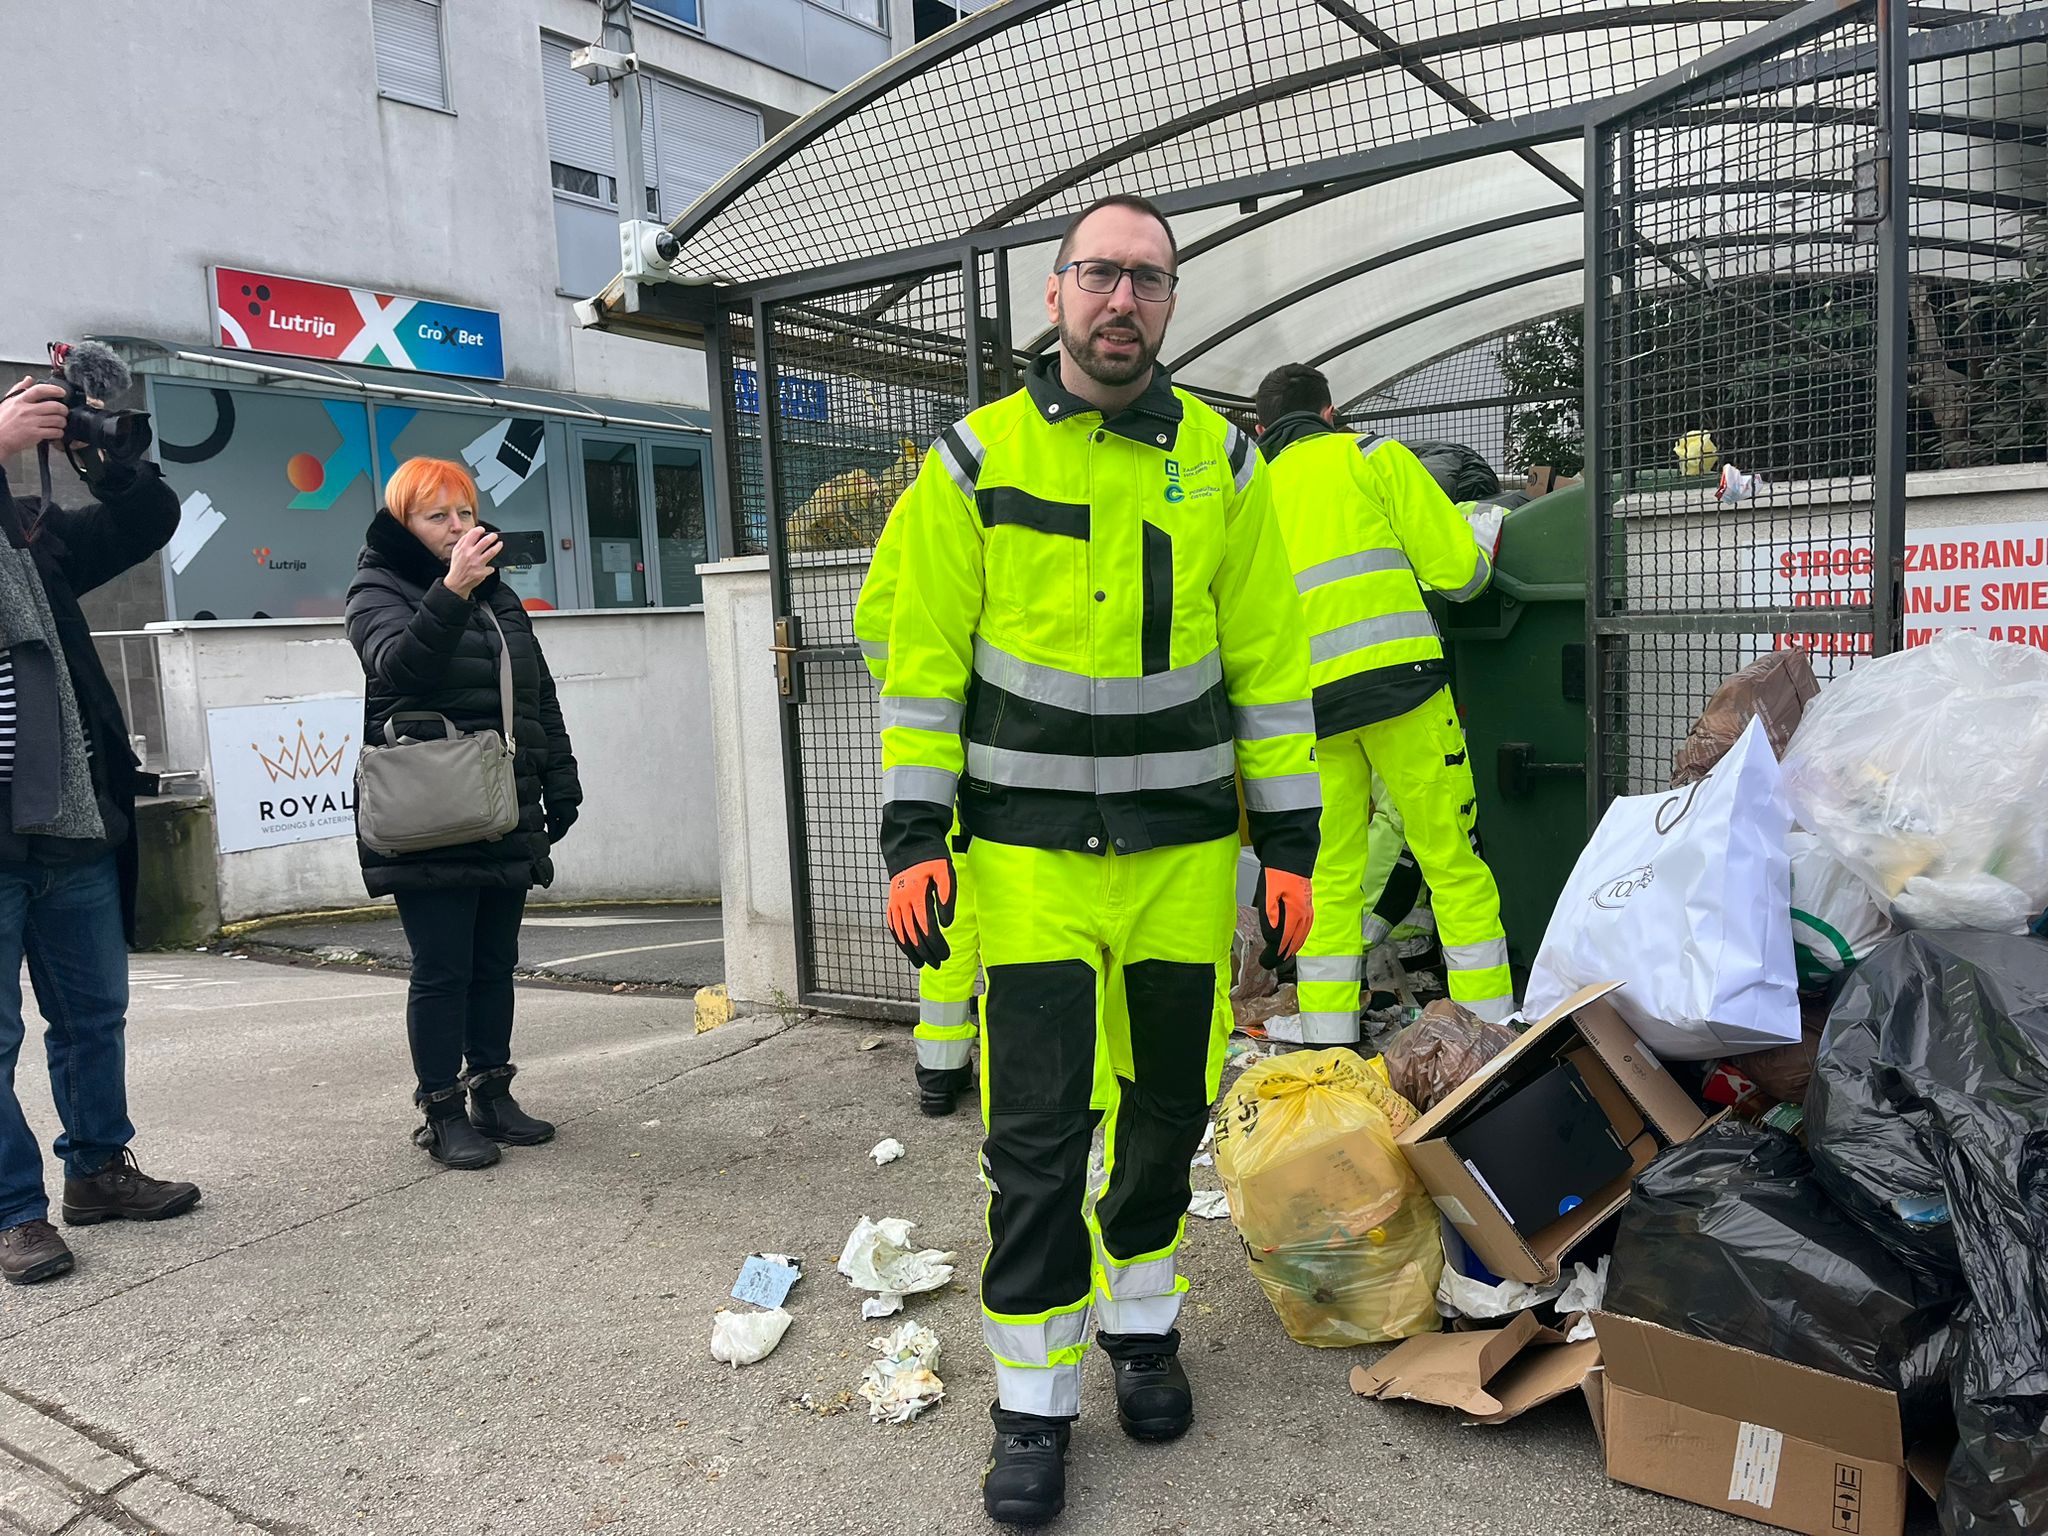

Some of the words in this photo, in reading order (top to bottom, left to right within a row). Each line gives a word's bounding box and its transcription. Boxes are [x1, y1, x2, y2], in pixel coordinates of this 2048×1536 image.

[269, 310, 336, 339] Lutrija
[418, 323, 484, 347] CroXBet
[269, 560, 307, 571] Lutrija
[1780, 547, 1874, 578] STROG
[1904, 538, 2048, 572] ZABRANJ
[260, 791, 354, 820] ROYAL
[261, 821, 307, 834] WEDDINGS
[309, 819, 316, 828] &
